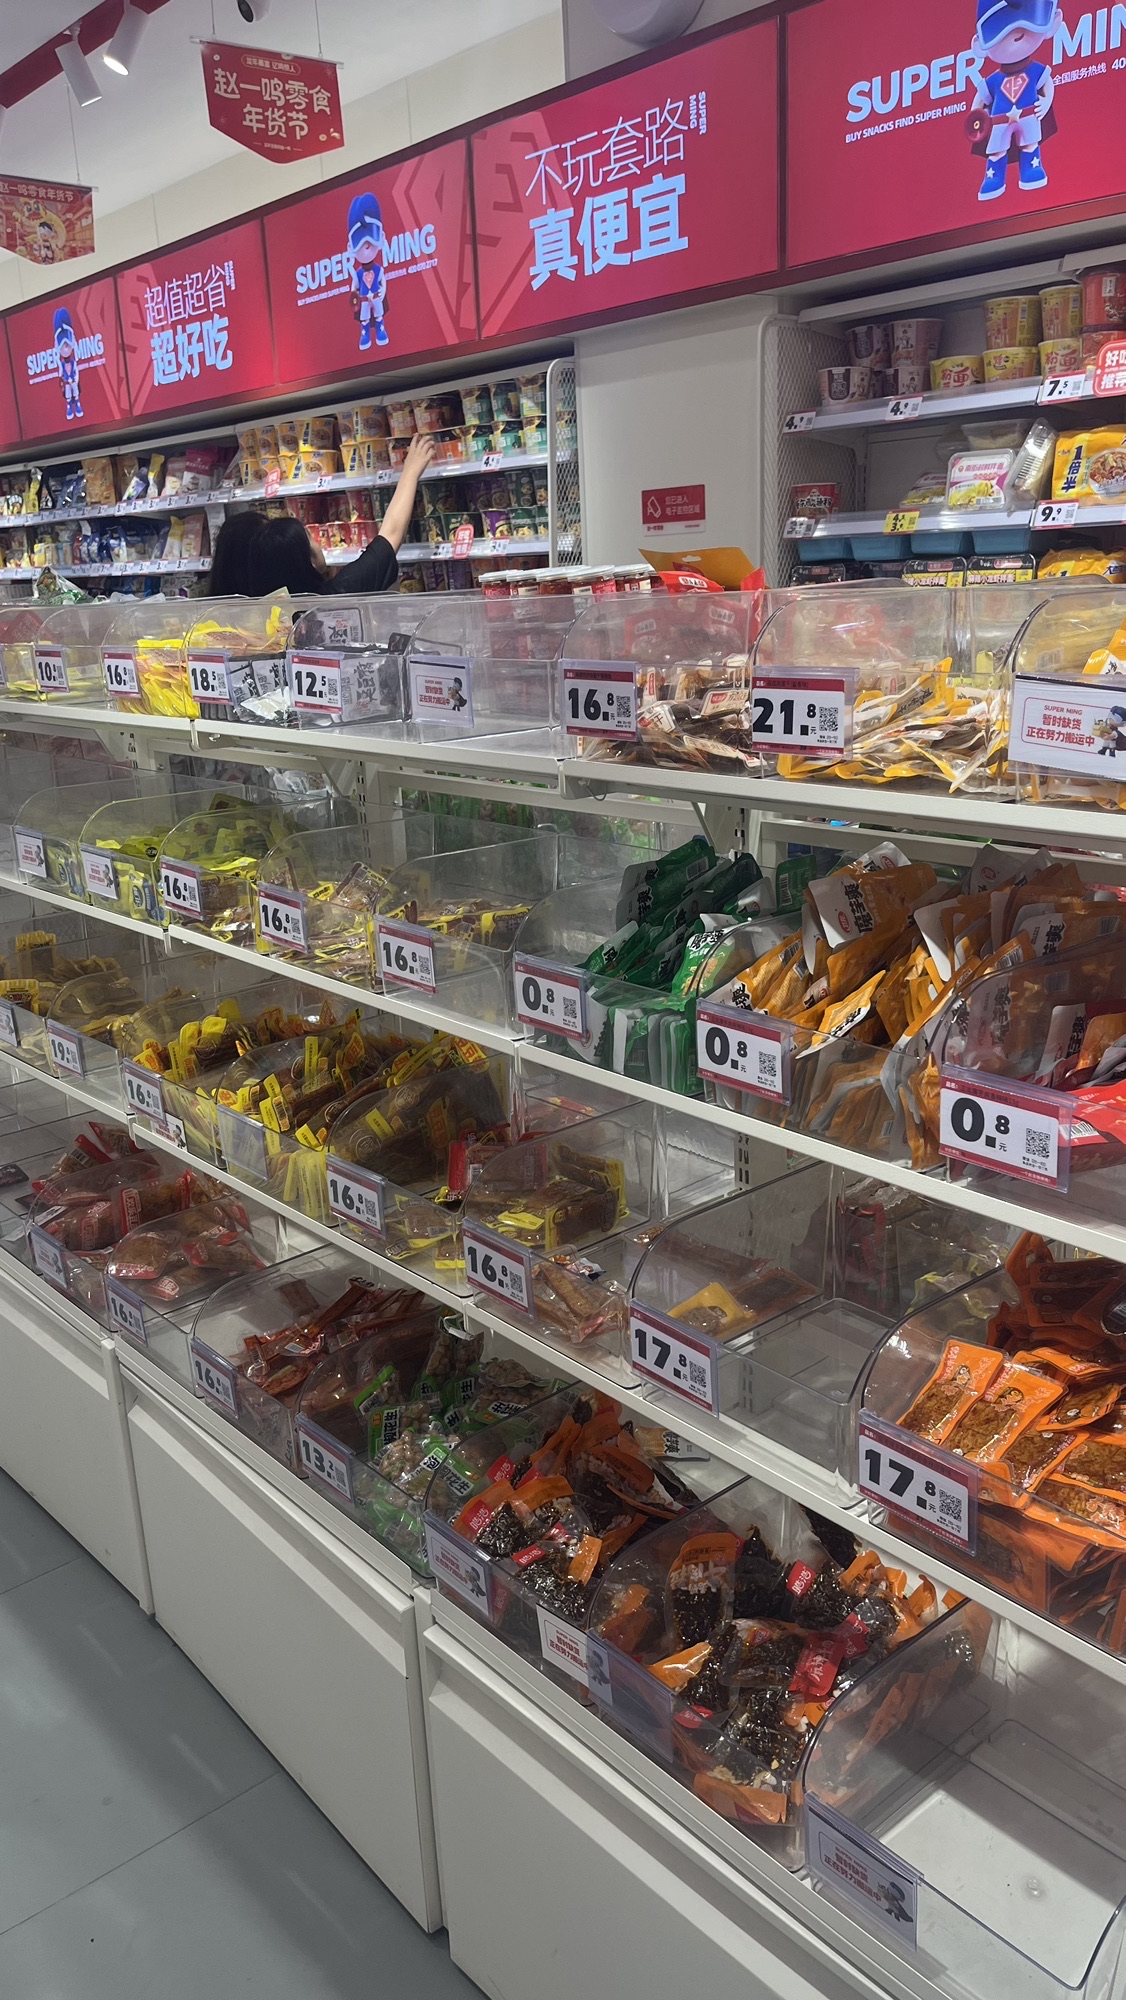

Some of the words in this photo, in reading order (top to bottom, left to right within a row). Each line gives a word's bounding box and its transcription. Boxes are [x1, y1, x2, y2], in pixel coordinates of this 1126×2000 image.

[213, 68, 331, 115] 赵一鸣零食
[845, 50, 985, 123] SUPER
[1052, 62, 1107, 86] 全国服务热线
[242, 103, 309, 140] 年货节
[689, 94, 698, 129] MING
[698, 91, 707, 135] SUPER
[845, 131, 862, 144] BUY
[863, 121, 895, 139] SNACKS
[895, 115, 914, 130] FIND
[915, 108, 942, 126] SUPER
[943, 101, 967, 116] MING
[524, 98, 688, 205] 不玩套路
[529, 173, 689, 291] 真便宜
[295, 251, 356, 294] SUPER
[381, 224, 437, 268] MING
[144, 264, 226, 331] 超值超省
[26, 348, 60, 376] SUPER
[74, 333, 105, 361] MING
[151, 313, 233, 386] 超好吃
[1047, 380, 1068, 397] 7.5
[890, 401, 909, 416] 4.9
[1061, 445, 1083, 493] 1倍半
[1041, 506, 1062, 522] 9.9
[107, 664, 127, 686] 16.8
[191, 668, 216, 692] 18.5
[295, 670, 327, 699] 12.5
[568, 687, 615, 721] 16.8
[752, 697, 817, 736] 21.8
[1042, 713, 1082, 731] 暂时缺货
[1044, 705, 1065, 714] SUPER
[1066, 707, 1083, 716] MING
[1026, 726, 1096, 748] 正在努力搬运中
[164, 875, 188, 902] 16.8
[262, 904, 290, 934] 16.8
[383, 941, 417, 974] 16.8
[522, 977, 555, 1014] 0.8
[705, 1027, 748, 1070] 0.8
[740, 1065, 747, 1073] 元
[128, 1080, 152, 1107] 16.8
[951, 1097, 1010, 1149] 0.8
[999, 1142, 1008, 1152] 元
[330, 1178, 364, 1213] 16.8
[467, 1245, 508, 1289] 16.8
[635, 1328, 688, 1380] 17.8
[302, 1440, 334, 1480] 13.2
[865, 1448, 937, 1510] 17.8
[928, 1503, 937, 1514] 元
[824, 1853, 882, 1902] 正在努力搬运中
